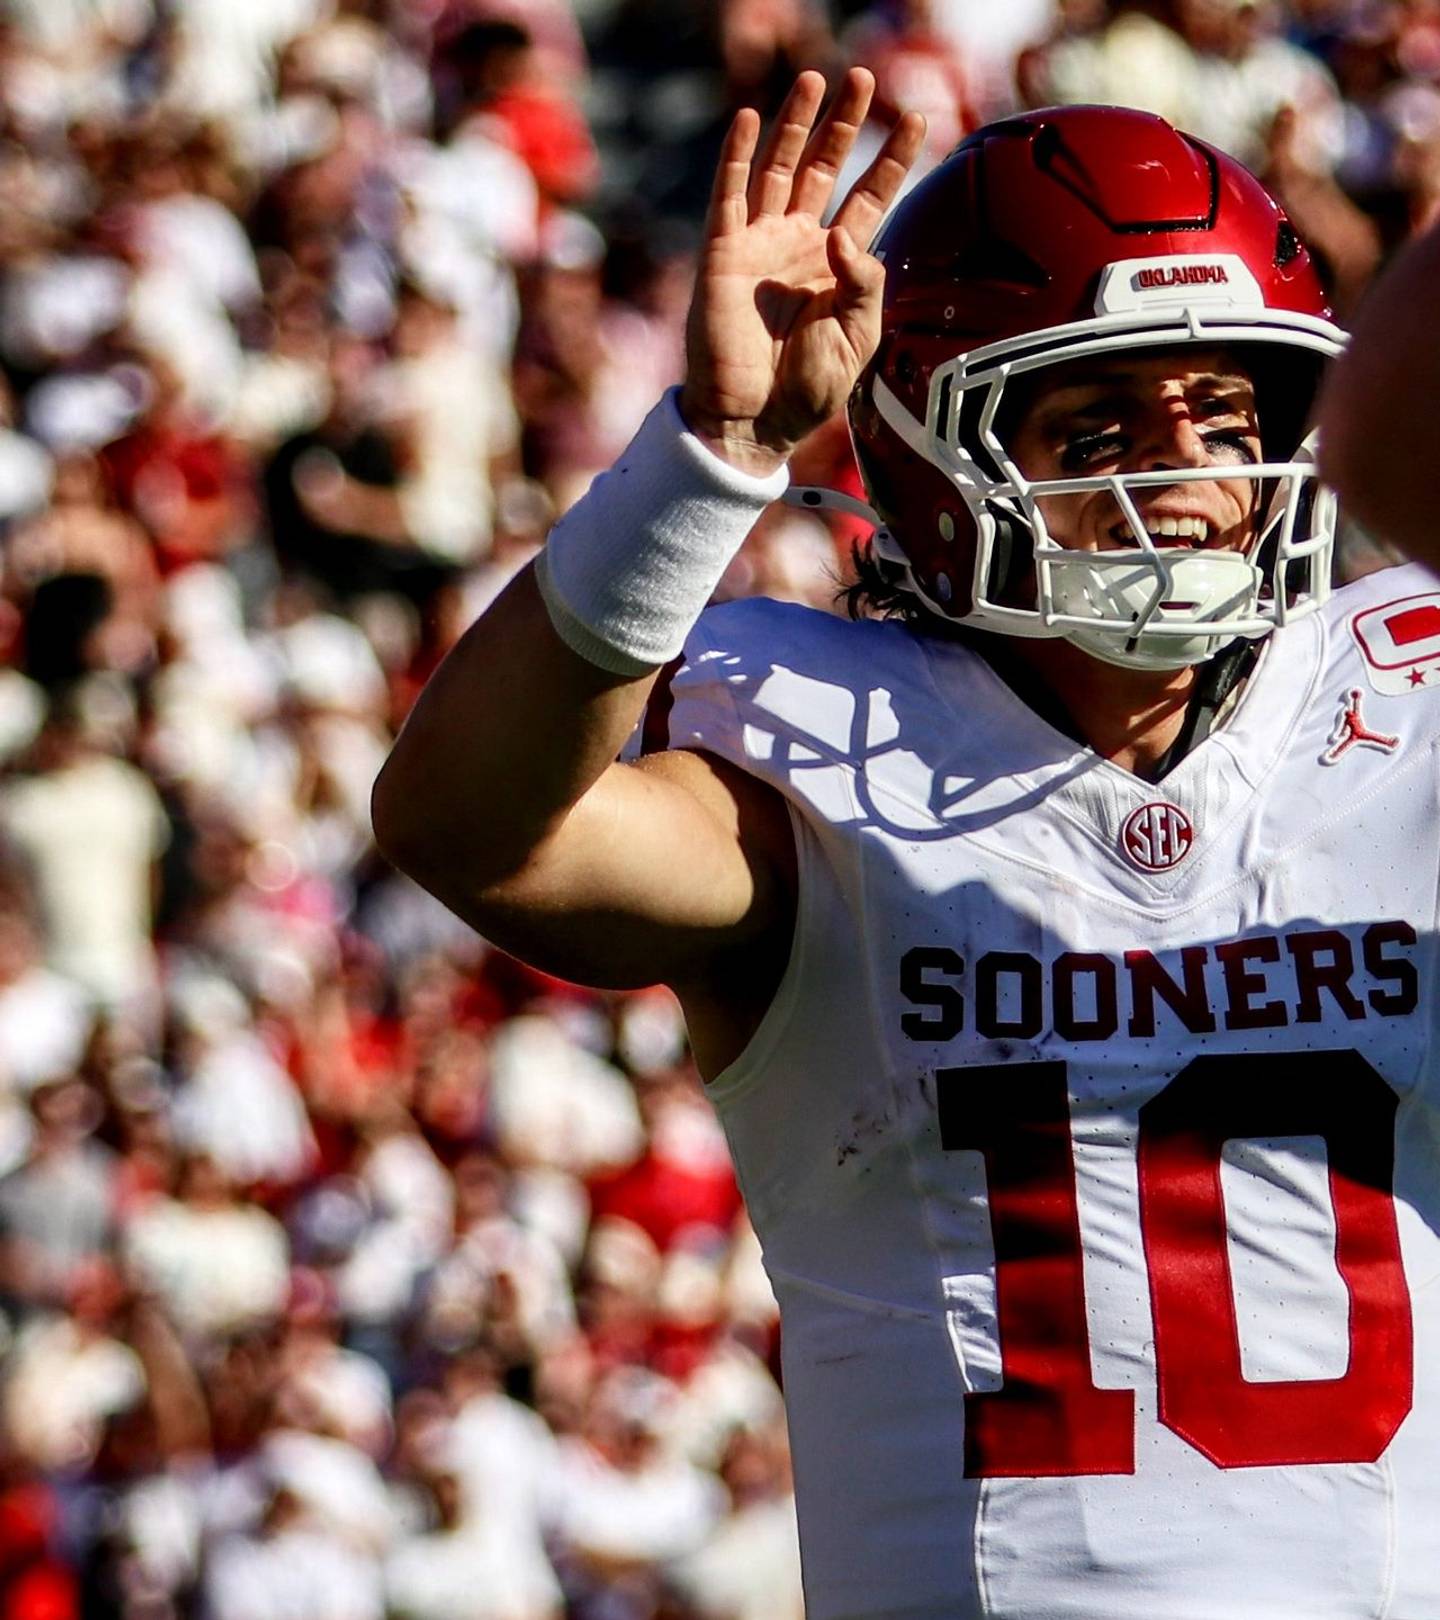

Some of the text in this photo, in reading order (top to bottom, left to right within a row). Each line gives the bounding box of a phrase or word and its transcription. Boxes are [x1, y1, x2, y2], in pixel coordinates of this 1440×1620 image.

[1138, 265, 1229, 288] OKLAHOMA
[1129, 806, 1188, 866] SEC
[900, 919, 1419, 1042] SOONERS
[936, 1048, 1414, 1479] 10
